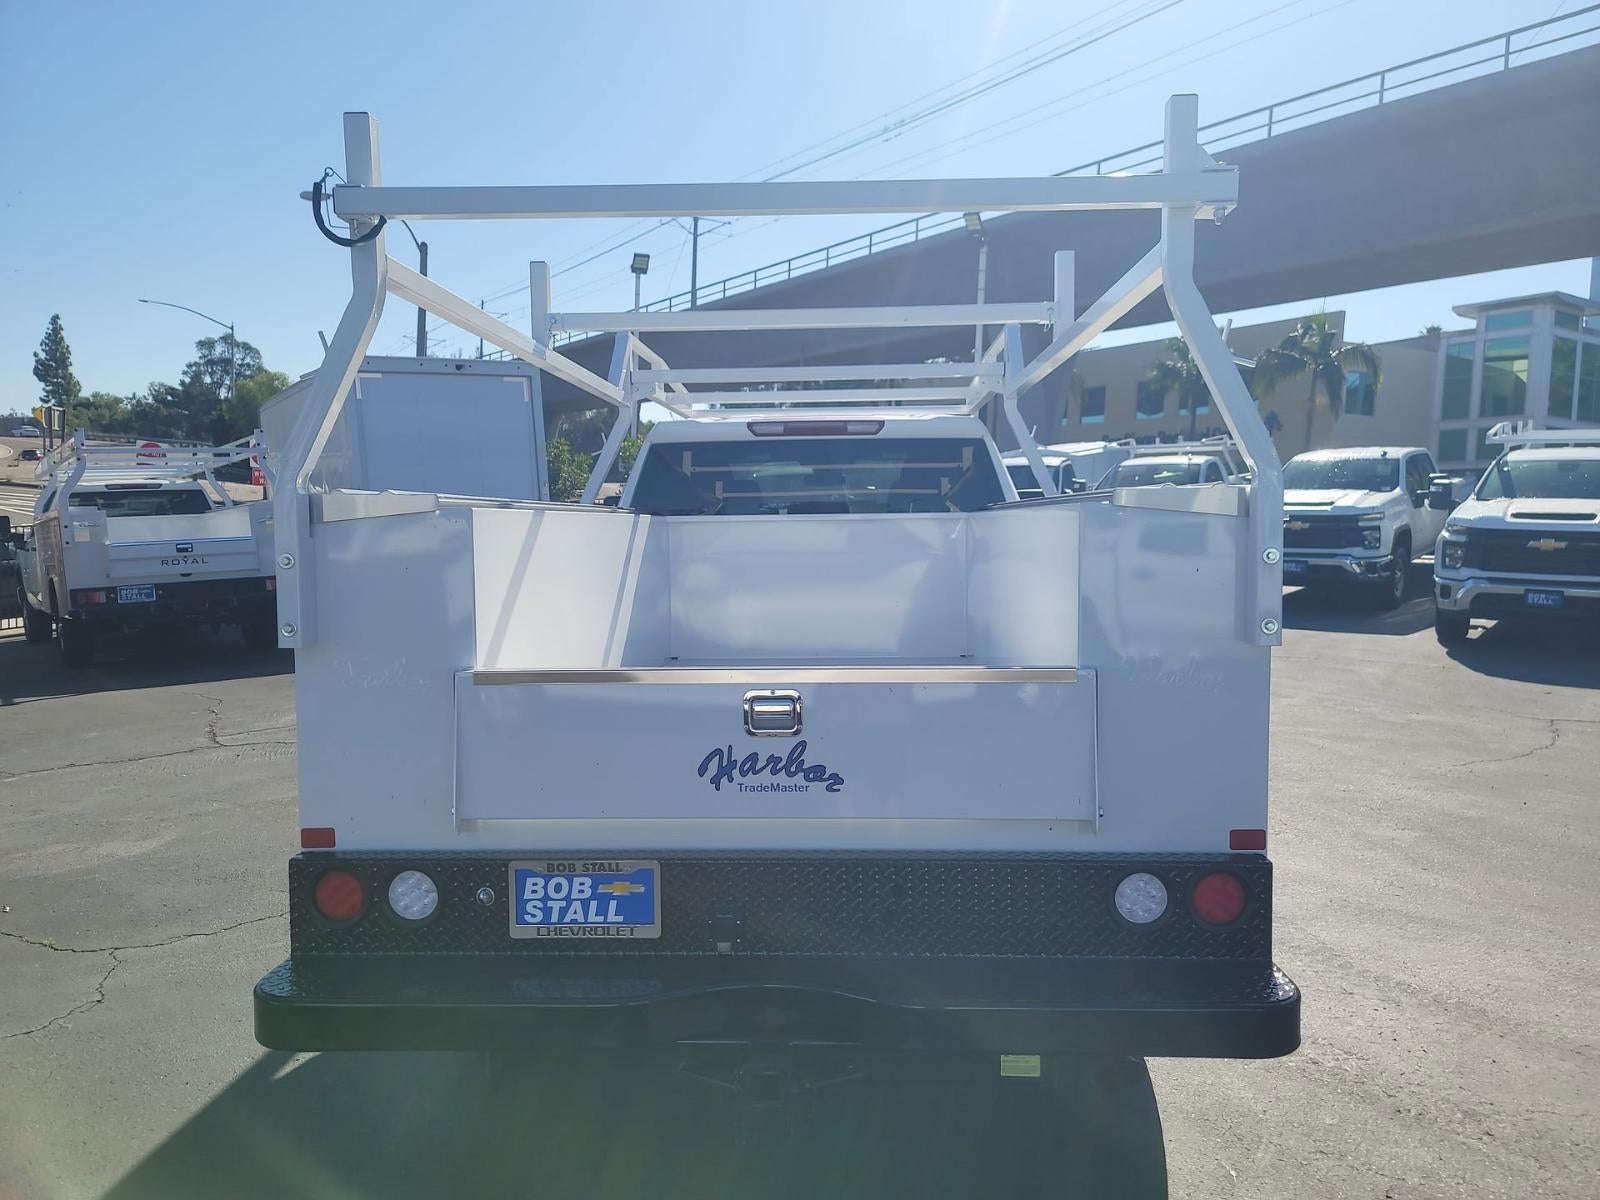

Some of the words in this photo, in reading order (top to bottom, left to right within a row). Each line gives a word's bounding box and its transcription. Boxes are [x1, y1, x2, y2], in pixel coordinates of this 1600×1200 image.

[160, 556, 209, 567] ROYAL
[697, 740, 845, 793] Harbor
[737, 782, 810, 793] TradeMaster
[546, 863, 576, 873] BOB
[582, 862, 623, 873] STALL
[523, 876, 593, 900] BOB
[523, 900, 624, 923] STALL
[536, 925, 638, 937] CHEVROLET
